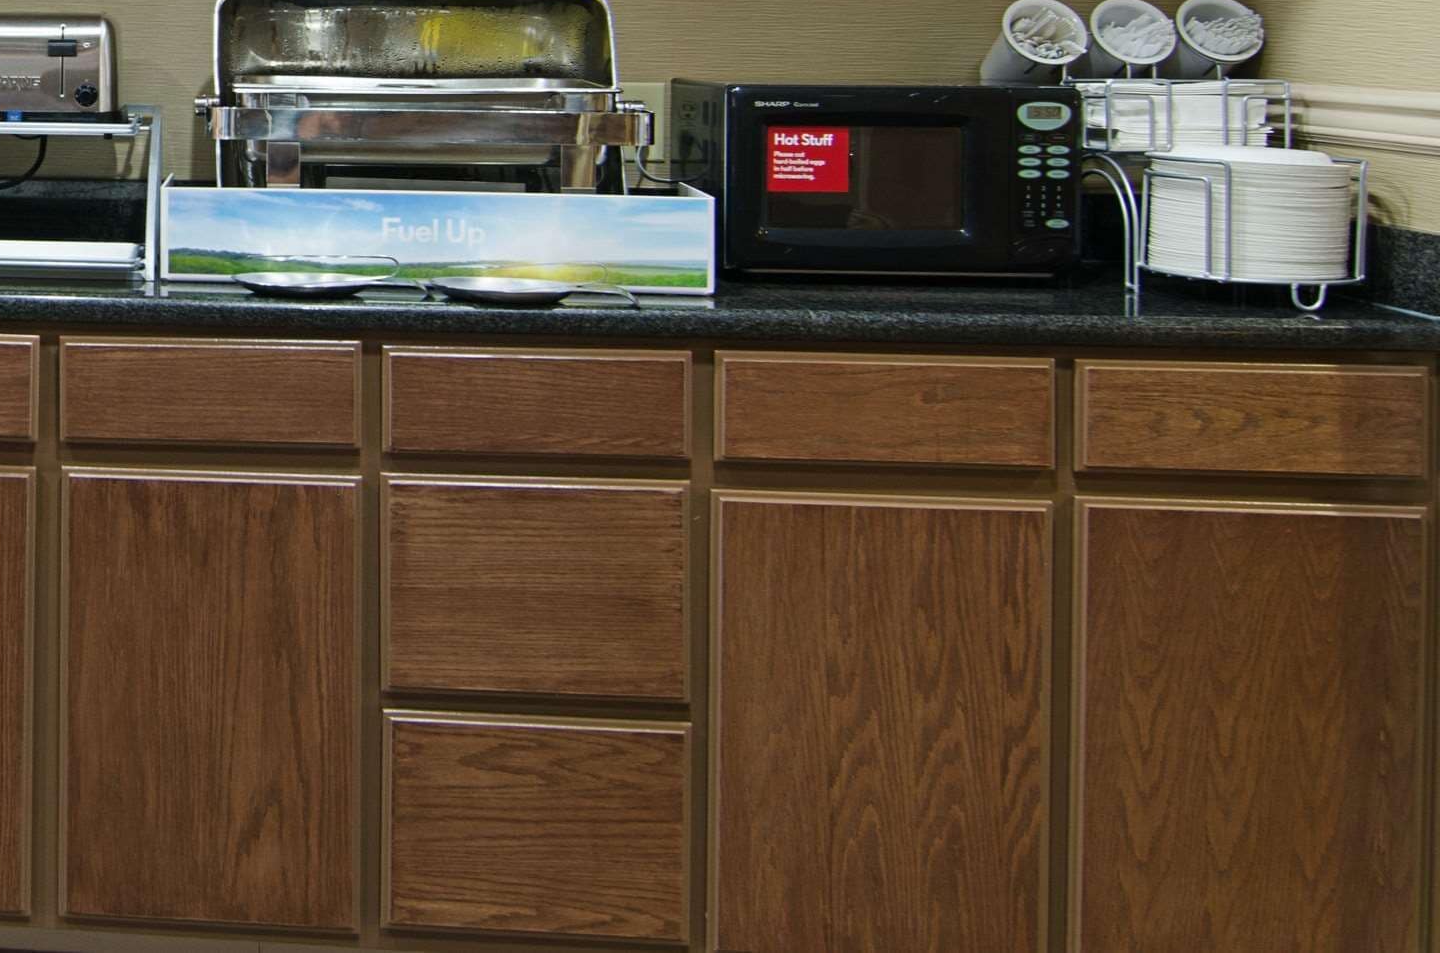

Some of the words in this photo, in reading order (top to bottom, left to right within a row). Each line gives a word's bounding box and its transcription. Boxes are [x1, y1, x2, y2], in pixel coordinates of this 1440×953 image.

[773, 132, 799, 146] Hot
[801, 133, 834, 146] Stuff
[381, 216, 440, 243] Fuel
[446, 217, 487, 250] Up
